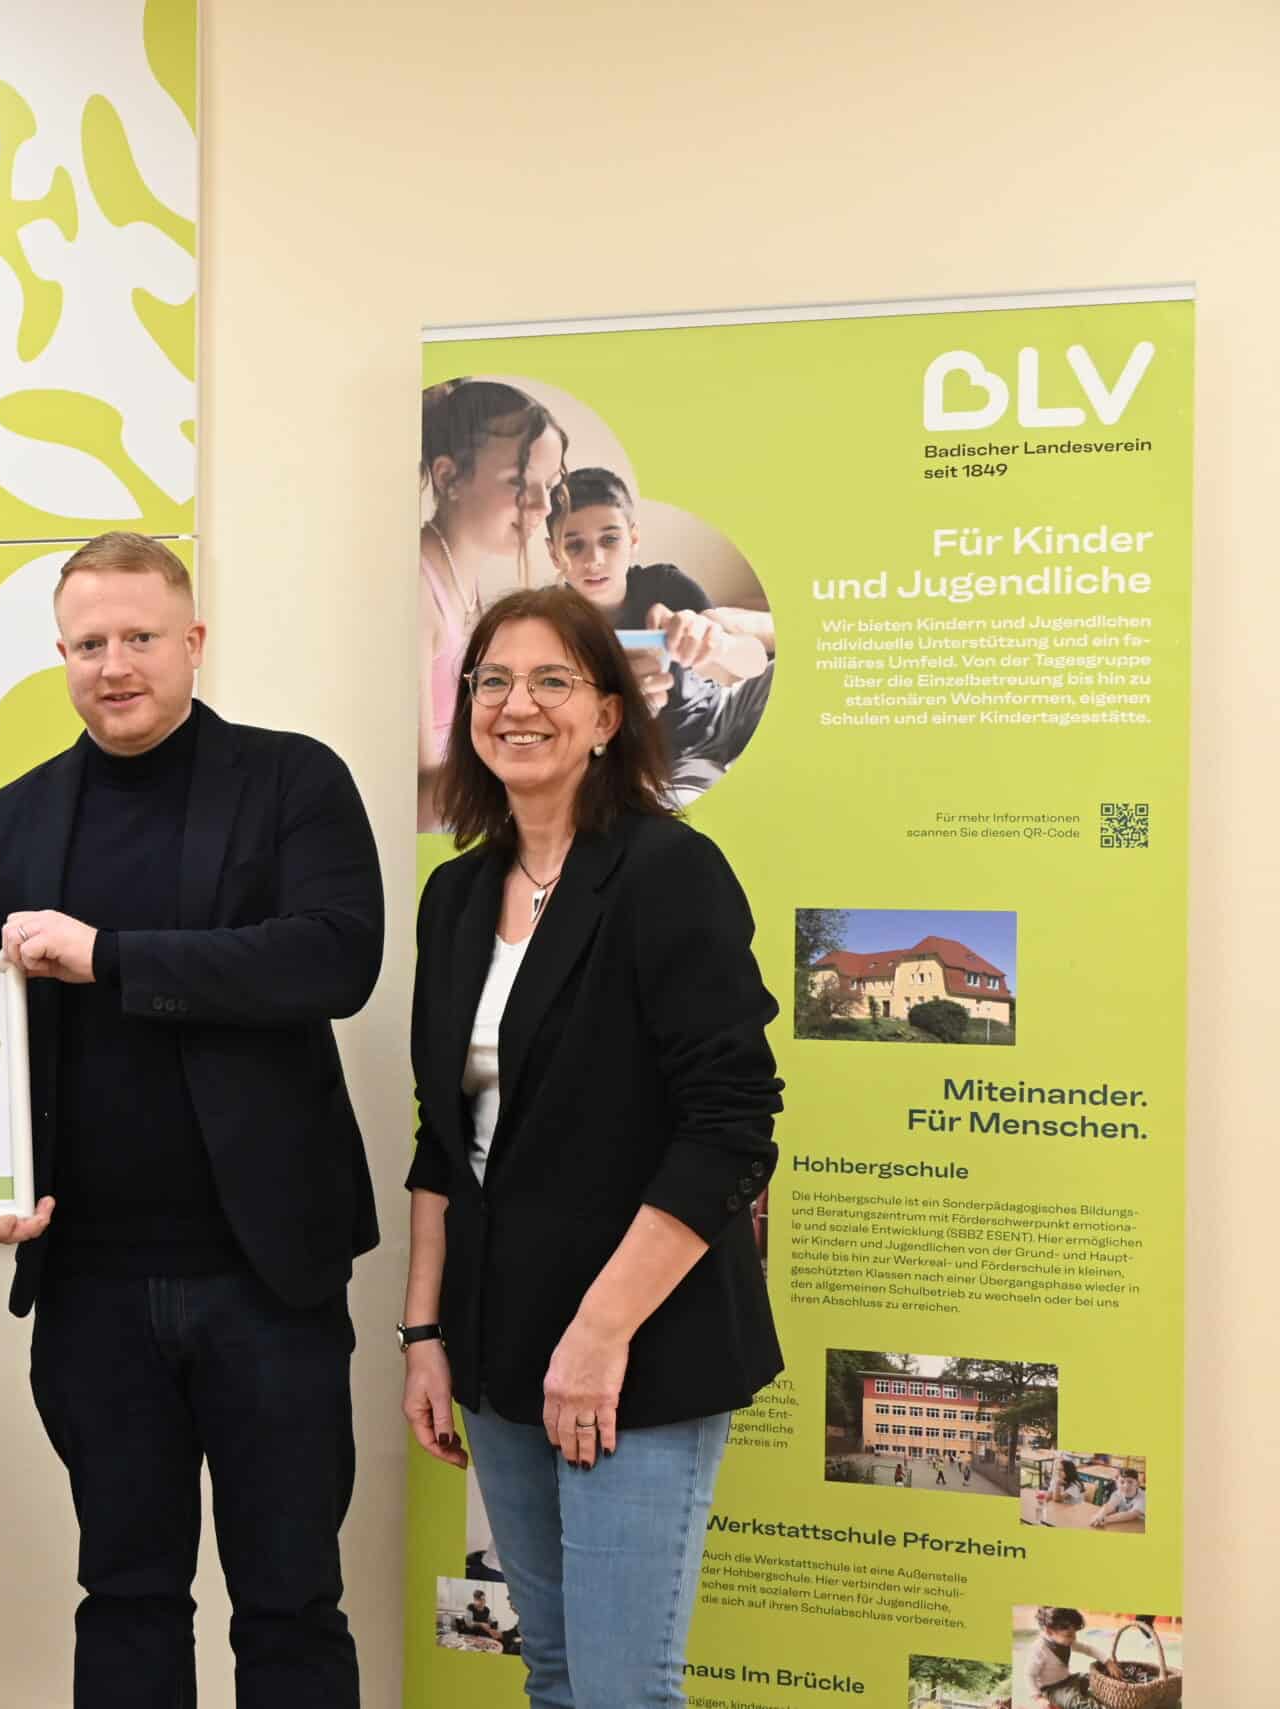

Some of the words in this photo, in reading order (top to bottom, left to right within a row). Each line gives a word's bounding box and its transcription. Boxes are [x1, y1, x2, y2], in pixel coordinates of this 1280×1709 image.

[923, 341, 1156, 432] BLV
[924, 442, 1019, 458] Badischer
[1023, 438, 1152, 455] Landesverein
[924, 465, 958, 479] seit
[962, 463, 1008, 478] 1849
[933, 528, 1003, 557] Für
[1013, 525, 1154, 555] Kinder
[812, 571, 887, 599] und
[896, 567, 1151, 602] Jugendliche
[822, 619, 856, 632] Wir
[857, 619, 912, 632] bieten
[916, 618, 987, 631] Kindern
[991, 617, 1025, 630] und
[1028, 616, 1152, 631] Jugendlichen
[816, 637, 914, 651] individuelle
[918, 636, 1050, 650] Unterstützung
[1052, 635, 1089, 648] und
[1091, 635, 1119, 647] ein
[1122, 635, 1151, 647] fa-
[816, 656, 884, 669] miliäres
[887, 655, 958, 668] Umfeld.
[961, 655, 996, 668] Von
[1000, 655, 1031, 667] der
[1032, 654, 1152, 669] Tagesgruppe
[844, 675, 884, 688] über
[887, 675, 913, 687] die
[917, 674, 1064, 688] Einzelbetreuung
[1067, 673, 1094, 686] bis
[1096, 673, 1126, 685] hin
[1128, 675, 1152, 685] zu
[846, 694, 947, 706] stationären
[950, 693, 1076, 705] Wohnformen,
[1079, 693, 1151, 706] eigenen
[820, 712, 890, 725] Schulen
[893, 712, 928, 724] und
[931, 712, 976, 724] einer
[979, 711, 1152, 725] Kindertagesstätte.
[935, 813, 957, 823] Für
[958, 813, 991, 823] mehr
[992, 813, 1080, 823] Informationen
[906, 830, 957, 838] scannen
[959, 828, 978, 838] Sie
[980, 828, 1020, 838] diesen
[1023, 828, 1080, 839] QR-Code
[944, 1078, 1148, 1106] Miteinander.
[908, 1109, 962, 1133] Für
[969, 1111, 1148, 1139] Menschen.
[793, 1156, 969, 1179] Hohbergschule
[791, 1191, 811, 1202] Die
[813, 1191, 903, 1206] Hohbergschule
[904, 1195, 920, 1206] ist
[921, 1196, 940, 1207] ein
[942, 1197, 1077, 1213] Sonderpädagogisches
[1080, 1203, 1140, 1217] Bildungs-
[791, 1207, 814, 1217] und
[814, 1207, 926, 1222] Beratungszentrum
[928, 1213, 949, 1223] mit
[951, 1213, 1070, 1229] Förderschwerpunkt
[1072, 1220, 1136, 1232] emotiona-
[791, 1220, 802, 1231] le
[803, 1221, 827, 1232] und
[828, 1223, 869, 1234] soziale
[871, 1224, 944, 1240] Entwicklung
[946, 1227, 984, 1240] (SBBZ
[986, 1229, 1035, 1242] ESENT).
[1037, 1232, 1063, 1244] Hier
[1065, 1234, 1142, 1247] ermöglichen
[791, 1235, 810, 1246] wir
[811, 1236, 857, 1249] Kindern
[859, 1239, 883, 1250] und
[884, 1240, 965, 1254] Jugendlichen
[967, 1246, 990, 1255] von
[992, 1245, 1012, 1256] der
[1015, 1246, 1059, 1259] Grund-
[1063, 1249, 1087, 1260] und
[1089, 1250, 1134, 1264] Haupt-
[791, 1250, 830, 1262] schule
[831, 1252, 849, 1263] bis
[851, 1253, 870, 1264] hin
[872, 1256, 892, 1265] zur
[893, 1255, 952, 1268] Werkreal-
[954, 1258, 978, 1270] und
[981, 1259, 1062, 1274] Förderschule
[1064, 1263, 1075, 1275] in
[1078, 1264, 1124, 1279] kleinen,
[790, 1266, 863, 1278] geschützten
[865, 1268, 912, 1281] Klassen
[914, 1272, 944, 1283] nach
[946, 1273, 976, 1284] einer
[979, 1273, 1082, 1290] Übergangsphase
[1084, 1280, 1125, 1292] wieder
[1128, 1282, 1139, 1293] in
[790, 1293, 820, 1305] ihren
[821, 1295, 883, 1308] Abschluss
[885, 1300, 899, 1309] zu
[901, 1300, 960, 1312] erreichen.
[768, 1408, 793, 1419] Ent-
[730, 1422, 794, 1435] ugendliche
[773, 1438, 789, 1449] im
[903, 1532, 1026, 1559] Pforzheim
[702, 1549, 732, 1563] Auch
[734, 1552, 752, 1565] die
[753, 1554, 851, 1573] Werkstattschule
[853, 1562, 867, 1575] ist
[869, 1564, 894, 1577] eine
[897, 1566, 968, 1583] Außenstelle
[701, 1564, 721, 1577] der
[722, 1566, 812, 1585] Hohbergschule.
[815, 1574, 840, 1587] Hier
[841, 1578, 901, 1592] verbinden
[903, 1583, 920, 1594] wir
[924, 1585, 966, 1598] schuli-
[701, 1580, 735, 1593] sches
[736, 1583, 757, 1595] mit
[759, 1586, 811, 1600] sozialem
[813, 1589, 854, 1604] Lernen
[856, 1593, 873, 1605] für
[875, 1595, 951, 1614] Jugendliche,
[701, 1593, 719, 1606] die
[720, 1596, 745, 1608] sich
[746, 1599, 766, 1610] auf
[768, 1600, 799, 1613] ihren
[800, 1602, 893, 1622] Schulabschluss
[895, 1613, 967, 1629] vorbereiten.
[742, 1665, 770, 1684] Im
[777, 1669, 865, 1694] Brückle
